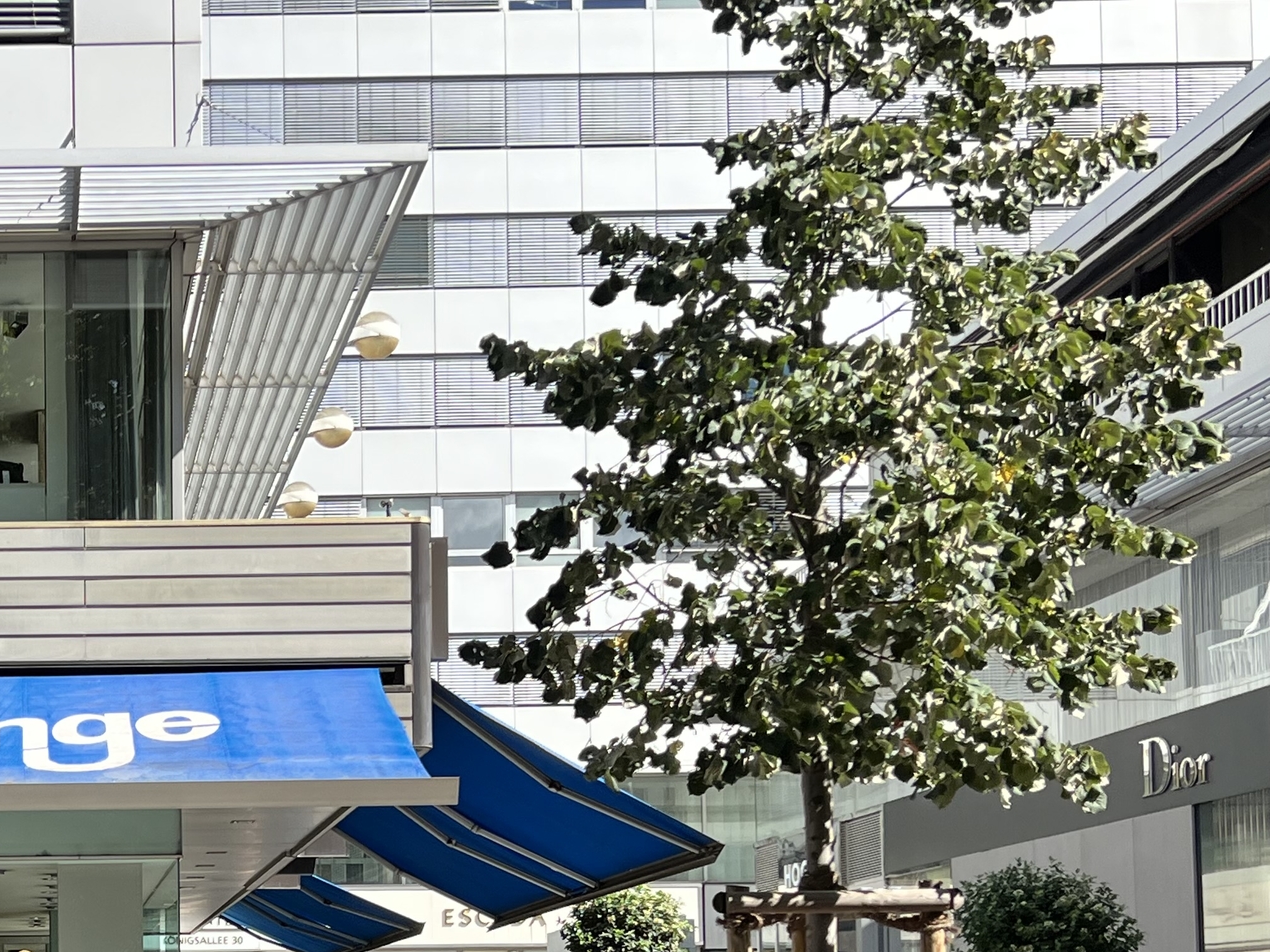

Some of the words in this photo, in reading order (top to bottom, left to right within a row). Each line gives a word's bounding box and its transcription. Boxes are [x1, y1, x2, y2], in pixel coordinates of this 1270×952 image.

[1138, 736, 1211, 798] Dior
[441, 907, 546, 928] ESCA
[163, 935, 229, 945] KÖNIGSALLEE
[231, 936, 244, 945] 30
